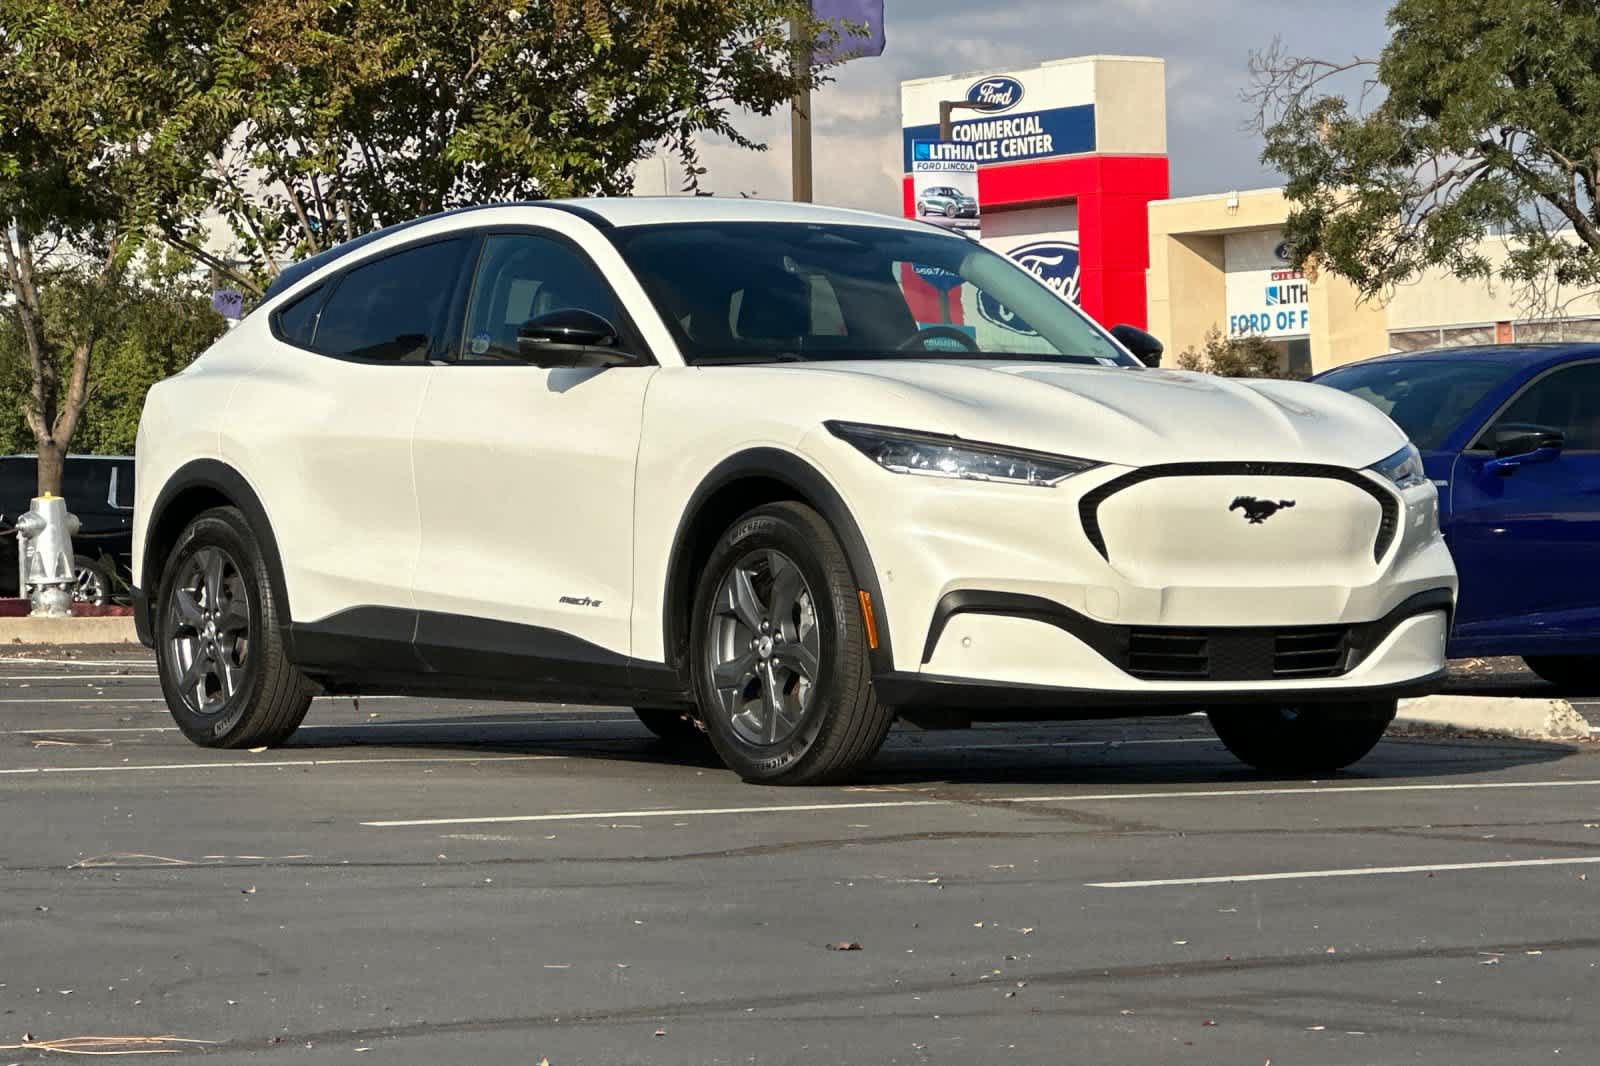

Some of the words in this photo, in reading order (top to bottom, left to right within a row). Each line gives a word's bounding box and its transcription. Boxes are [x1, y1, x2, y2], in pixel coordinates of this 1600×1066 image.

[977, 82, 1013, 105] Ford
[952, 115, 1044, 142] COMMERCIAL
[929, 143, 976, 160] LITHIA
[1001, 134, 1054, 157] CENTER
[917, 162, 942, 170] FORD
[943, 162, 975, 170] LINCOLN
[1279, 284, 1308, 304] LITH
[1230, 313, 1271, 334] FORD
[1276, 310, 1296, 330] OF
